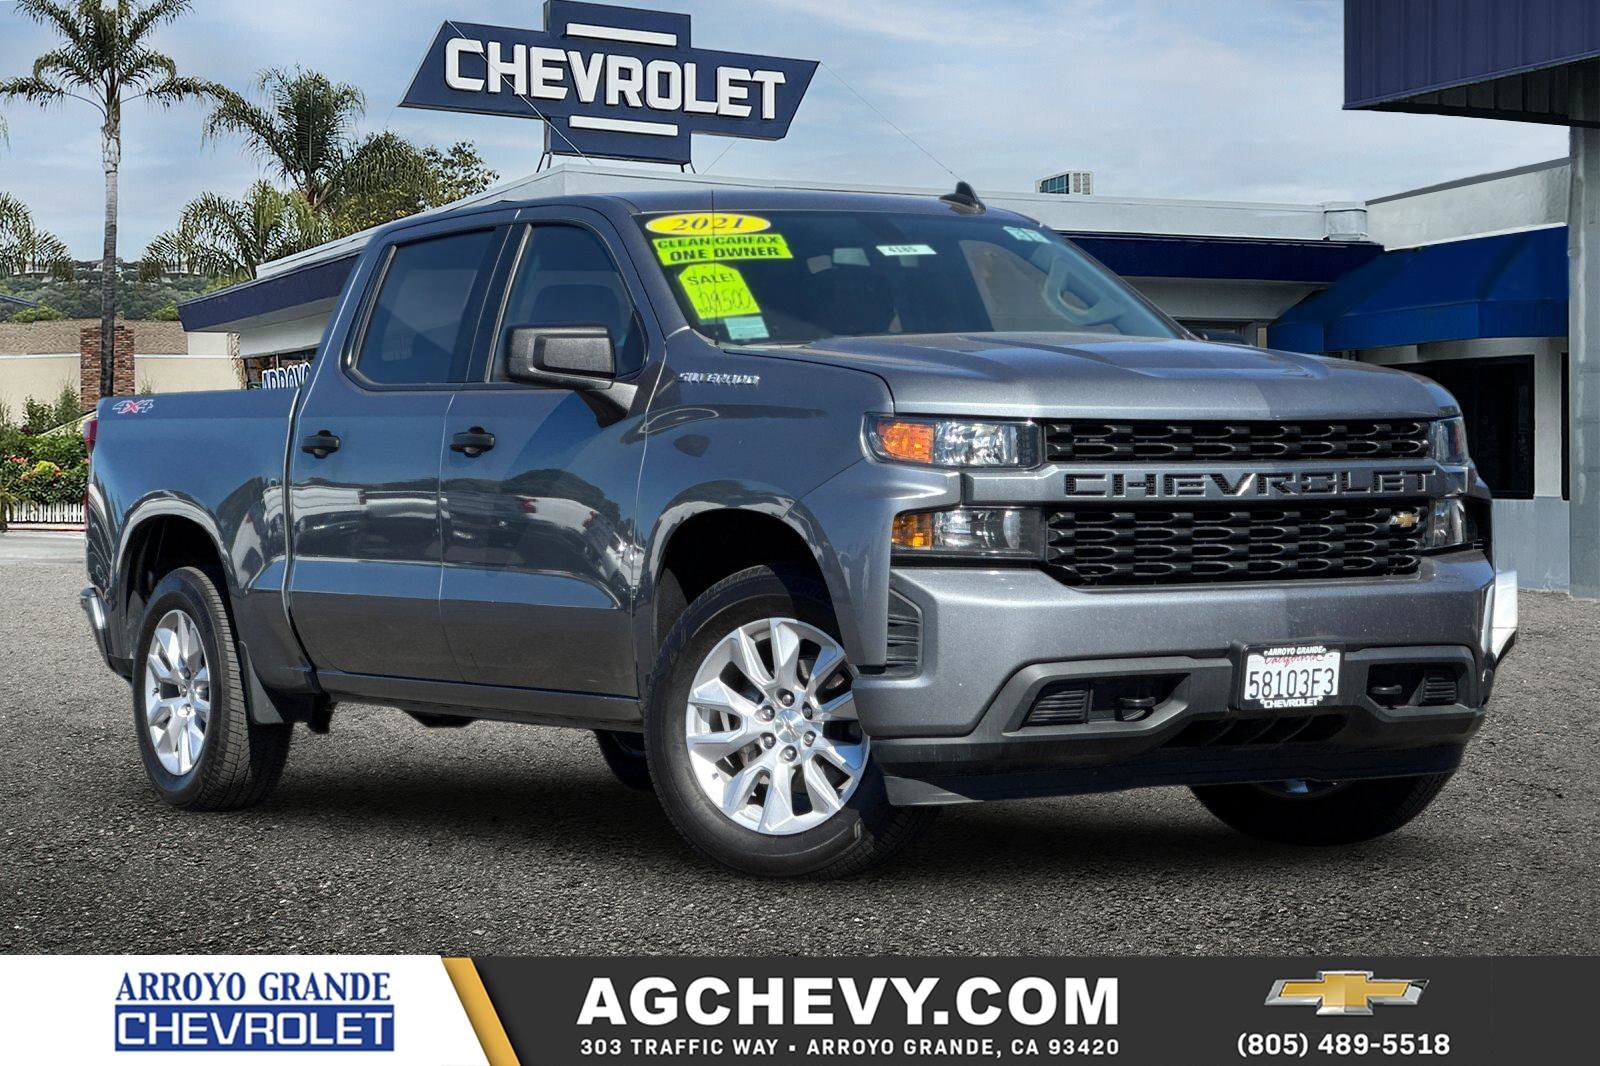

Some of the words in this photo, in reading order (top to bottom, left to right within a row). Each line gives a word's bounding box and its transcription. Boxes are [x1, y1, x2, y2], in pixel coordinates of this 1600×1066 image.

[445, 38, 786, 120] CHEVROLET
[671, 217, 745, 231] 2021
[657, 238, 710, 250] CLEAN
[715, 235, 779, 246] CARFAX
[670, 250, 708, 262] ONE
[714, 247, 780, 258] OWNER
[687, 273, 736, 286] SALE!
[1065, 469, 1436, 497] CHEVROLET
[1267, 647, 1296, 656] ARROYO
[1296, 645, 1324, 655] GRANDE
[1249, 667, 1335, 698] 58103F3
[1264, 698, 1319, 708] CHEVROLET
